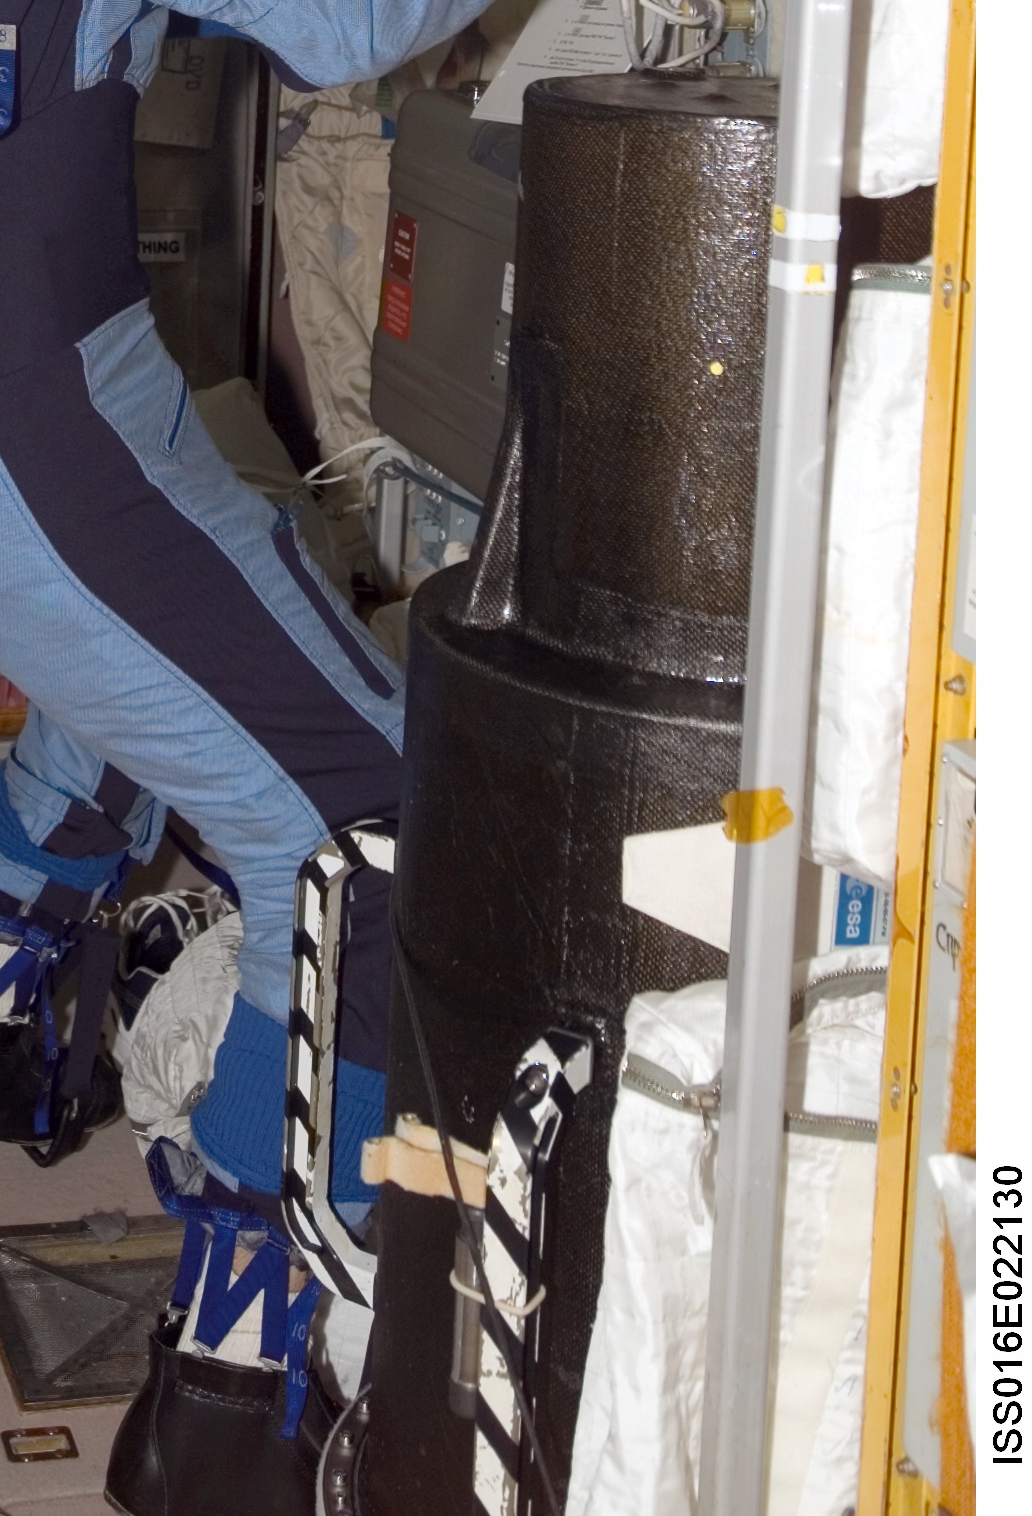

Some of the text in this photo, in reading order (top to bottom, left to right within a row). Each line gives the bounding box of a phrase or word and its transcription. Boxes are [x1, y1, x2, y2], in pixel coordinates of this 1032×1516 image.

[185, 55, 204, 91] DVD
[846, 899, 862, 938] esa
[292, 1322, 307, 1341] 10
[292, 1369, 308, 1388] 10
